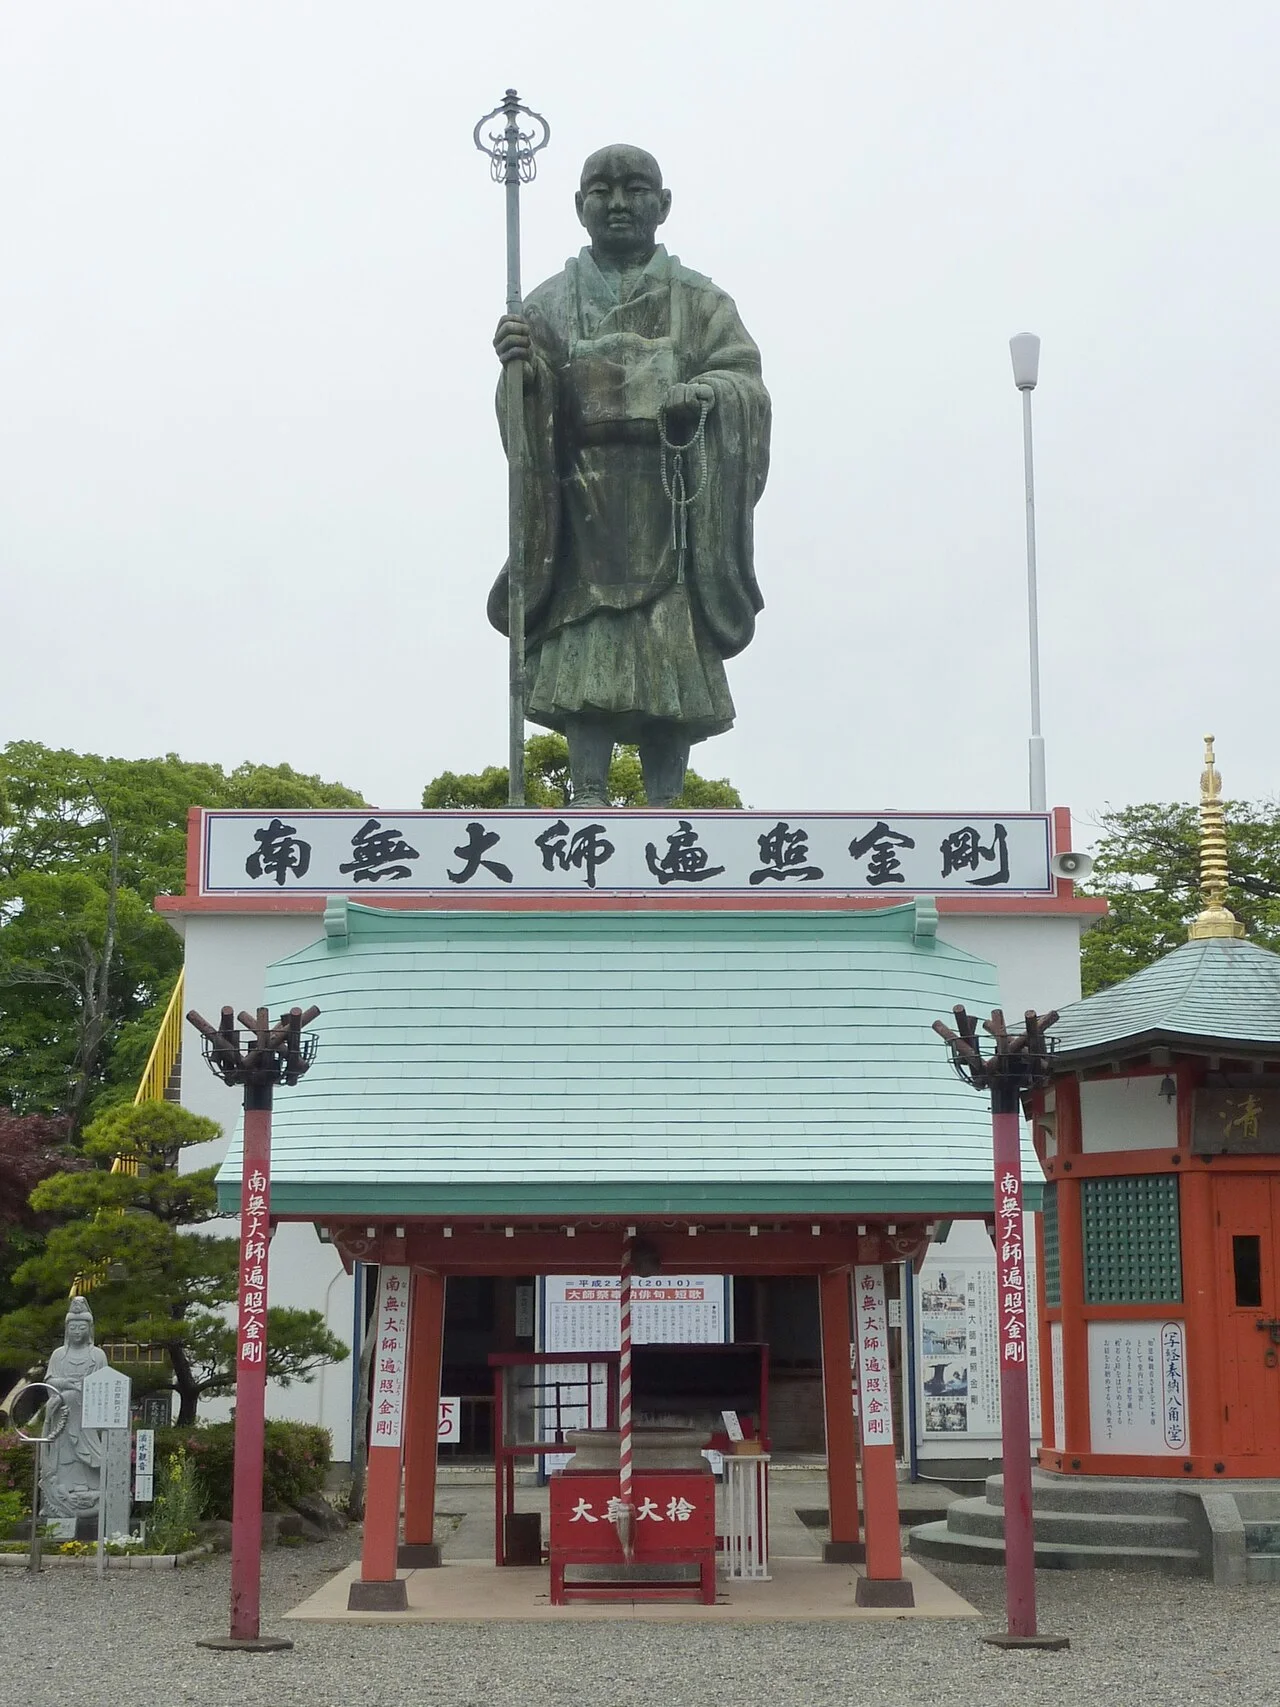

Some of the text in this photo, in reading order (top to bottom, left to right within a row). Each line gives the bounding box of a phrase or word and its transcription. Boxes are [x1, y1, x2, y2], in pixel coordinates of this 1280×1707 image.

[245, 819, 1009, 890] 南無大師遍照金剛
[241, 1170, 267, 1363] 南無大師遍照金剛
[999, 1172, 1024, 1363] 南無大師遍照金剛
[375, 1275, 400, 1436] 南無大師遍照金剛
[861, 1274, 884, 1434] 南無大師遍照金剛
[1164, 1331, 1183, 1442] 写経奉納八角堂
[569, 1495, 697, 1524] 大喜大捨
